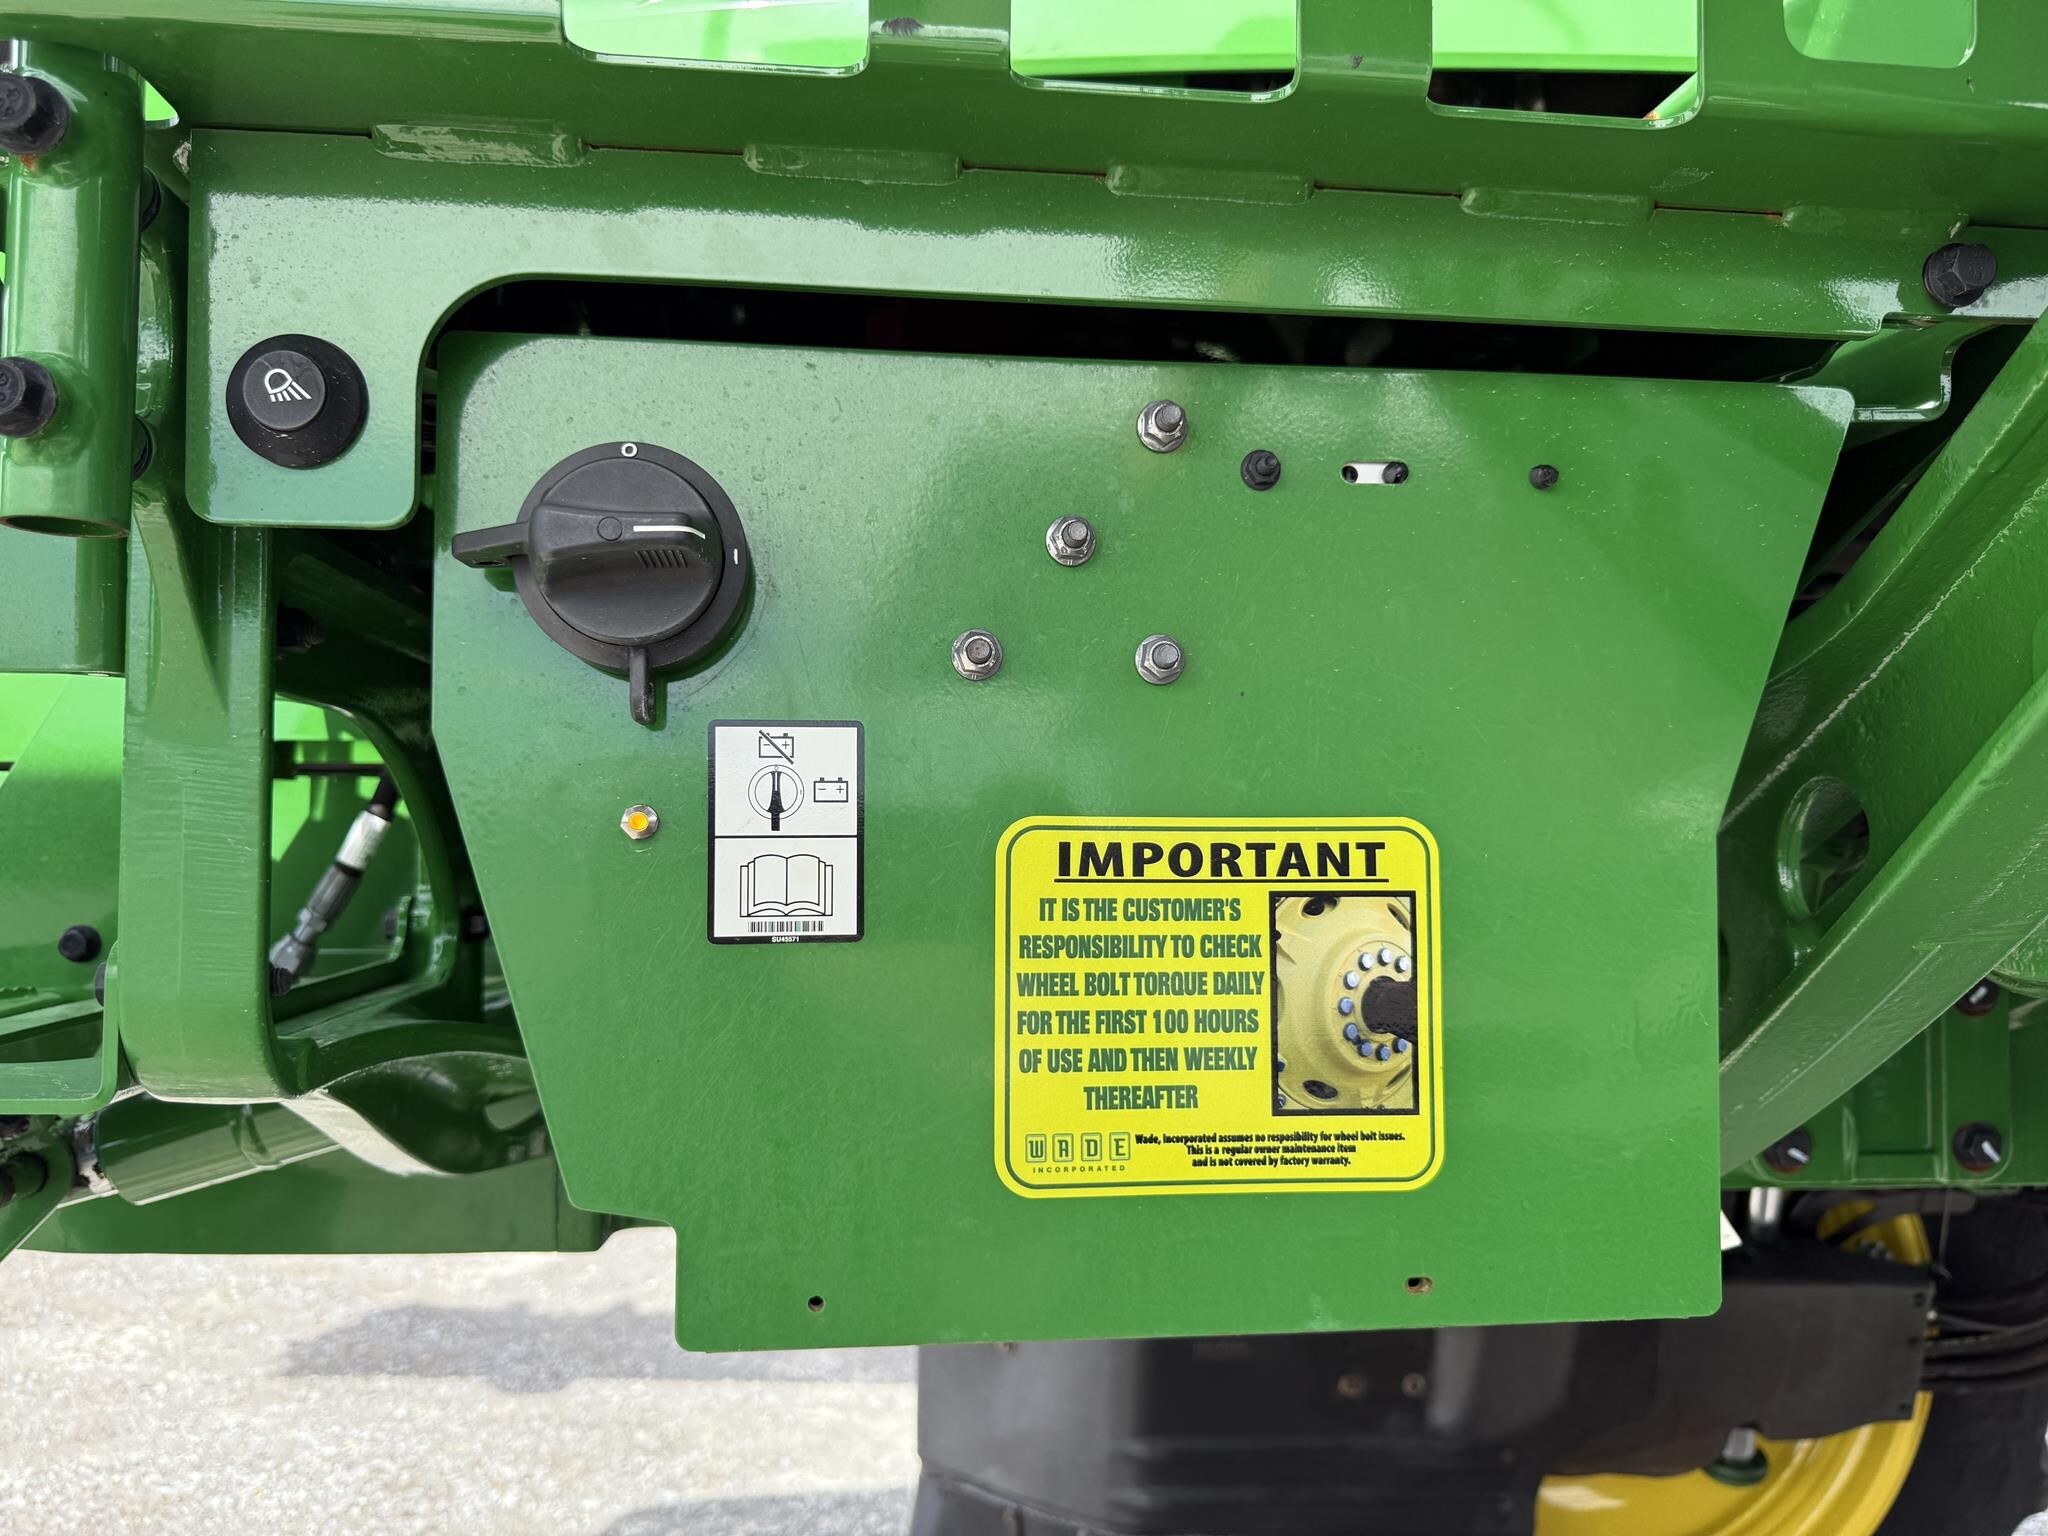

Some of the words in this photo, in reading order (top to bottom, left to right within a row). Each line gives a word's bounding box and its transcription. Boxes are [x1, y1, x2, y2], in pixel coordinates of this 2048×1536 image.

[1058, 842, 1386, 878] IMPORTANT
[1039, 897, 1057, 922] IT
[1061, 897, 1080, 922] IS
[1082, 897, 1118, 922] THE
[1122, 897, 1242, 922] CUSTOMER'S
[1019, 934, 1168, 959] RESPONSIBILITY
[1170, 934, 1195, 959] TO
[1199, 933, 1262, 958] CHECK
[1017, 972, 1079, 997] WHEEL
[1084, 971, 1131, 996] BOLT
[1132, 971, 1208, 996] TORQUE
[1212, 970, 1266, 995] DAILY
[1017, 1010, 1052, 1035] FOR
[1054, 1009, 1090, 1035] THE
[1095, 1009, 1147, 1034] FIRST
[1152, 1009, 1188, 1034] 100
[1193, 1008, 1259, 1033] HOURS
[1018, 1048, 1042, 1074] OF
[1047, 1048, 1083, 1073] USE
[1087, 1047, 1127, 1072] AND
[1129, 1047, 1178, 1072] THEN
[1183, 1046, 1258, 1071] WEEKLY
[1083, 1085, 1198, 1111] THEREAFTER
[1028, 1138, 1127, 1159] WADE
[1135, 1133, 1160, 1145] Wade,
[1163, 1132, 1217, 1145] Incorporated
[1218, 1133, 1253, 1143] assumes
[1255, 1133, 1266, 1142] no
[1319, 1131, 1333, 1142] for
[1334, 1131, 1359, 1141] wheel
[1360, 1131, 1377, 1141] bolt
[1378, 1131, 1405, 1141] issues.
[1187, 1145, 1204, 1156] This
[1205, 1145, 1212, 1155] is
[1222, 1144, 1253, 1156] regular
[1254, 1145, 1280, 1154] owner
[1281, 1144, 1336, 1153] maintenance
[1337, 1143, 1356, 1153] item
[1032, 1165, 1125, 1173] INCORPORATED
[1192, 1157, 1208, 1167] and
[1209, 1157, 1217, 1167] is
[1218, 1157, 1233, 1167] not
[1234, 1157, 1267, 1166] covered
[1268, 1156, 1279, 1168] by
[1280, 1155, 1310, 1168] factory
[1311, 1156, 1351, 1168] warranty.
